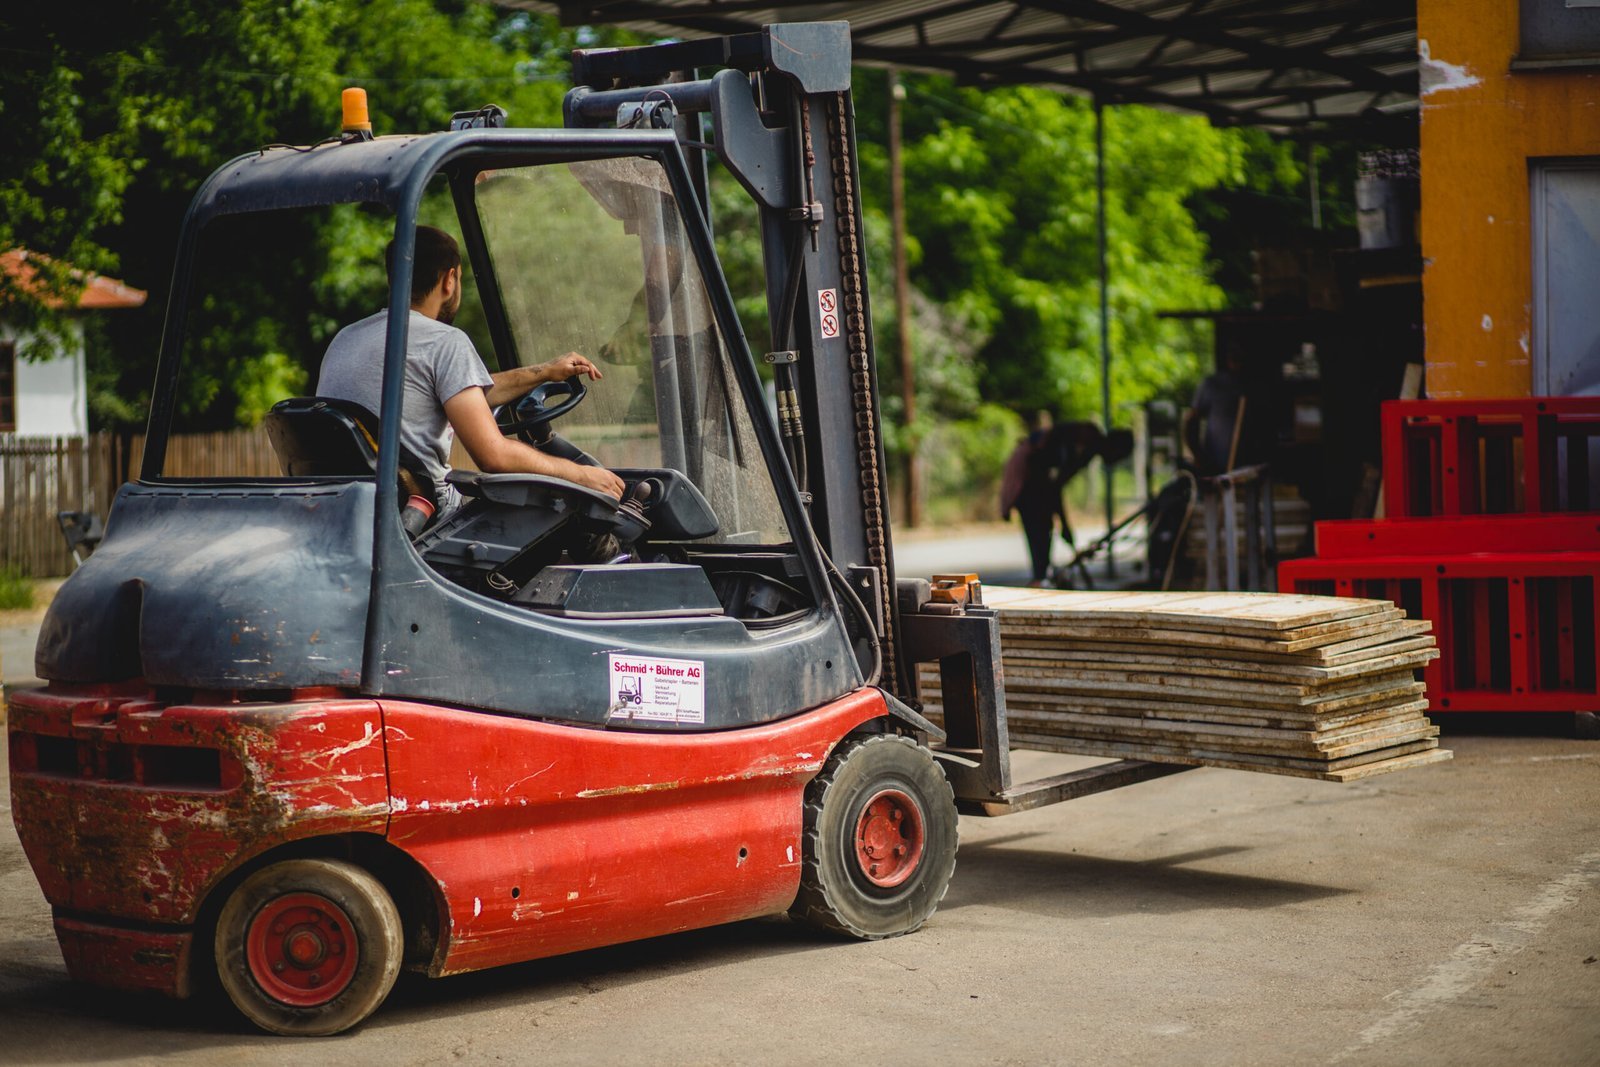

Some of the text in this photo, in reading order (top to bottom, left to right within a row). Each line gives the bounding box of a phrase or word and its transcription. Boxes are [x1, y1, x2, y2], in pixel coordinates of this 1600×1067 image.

[614, 661, 647, 674] Schmid
[656, 664, 684, 677] Bührer
[687, 667, 700, 678] AG
